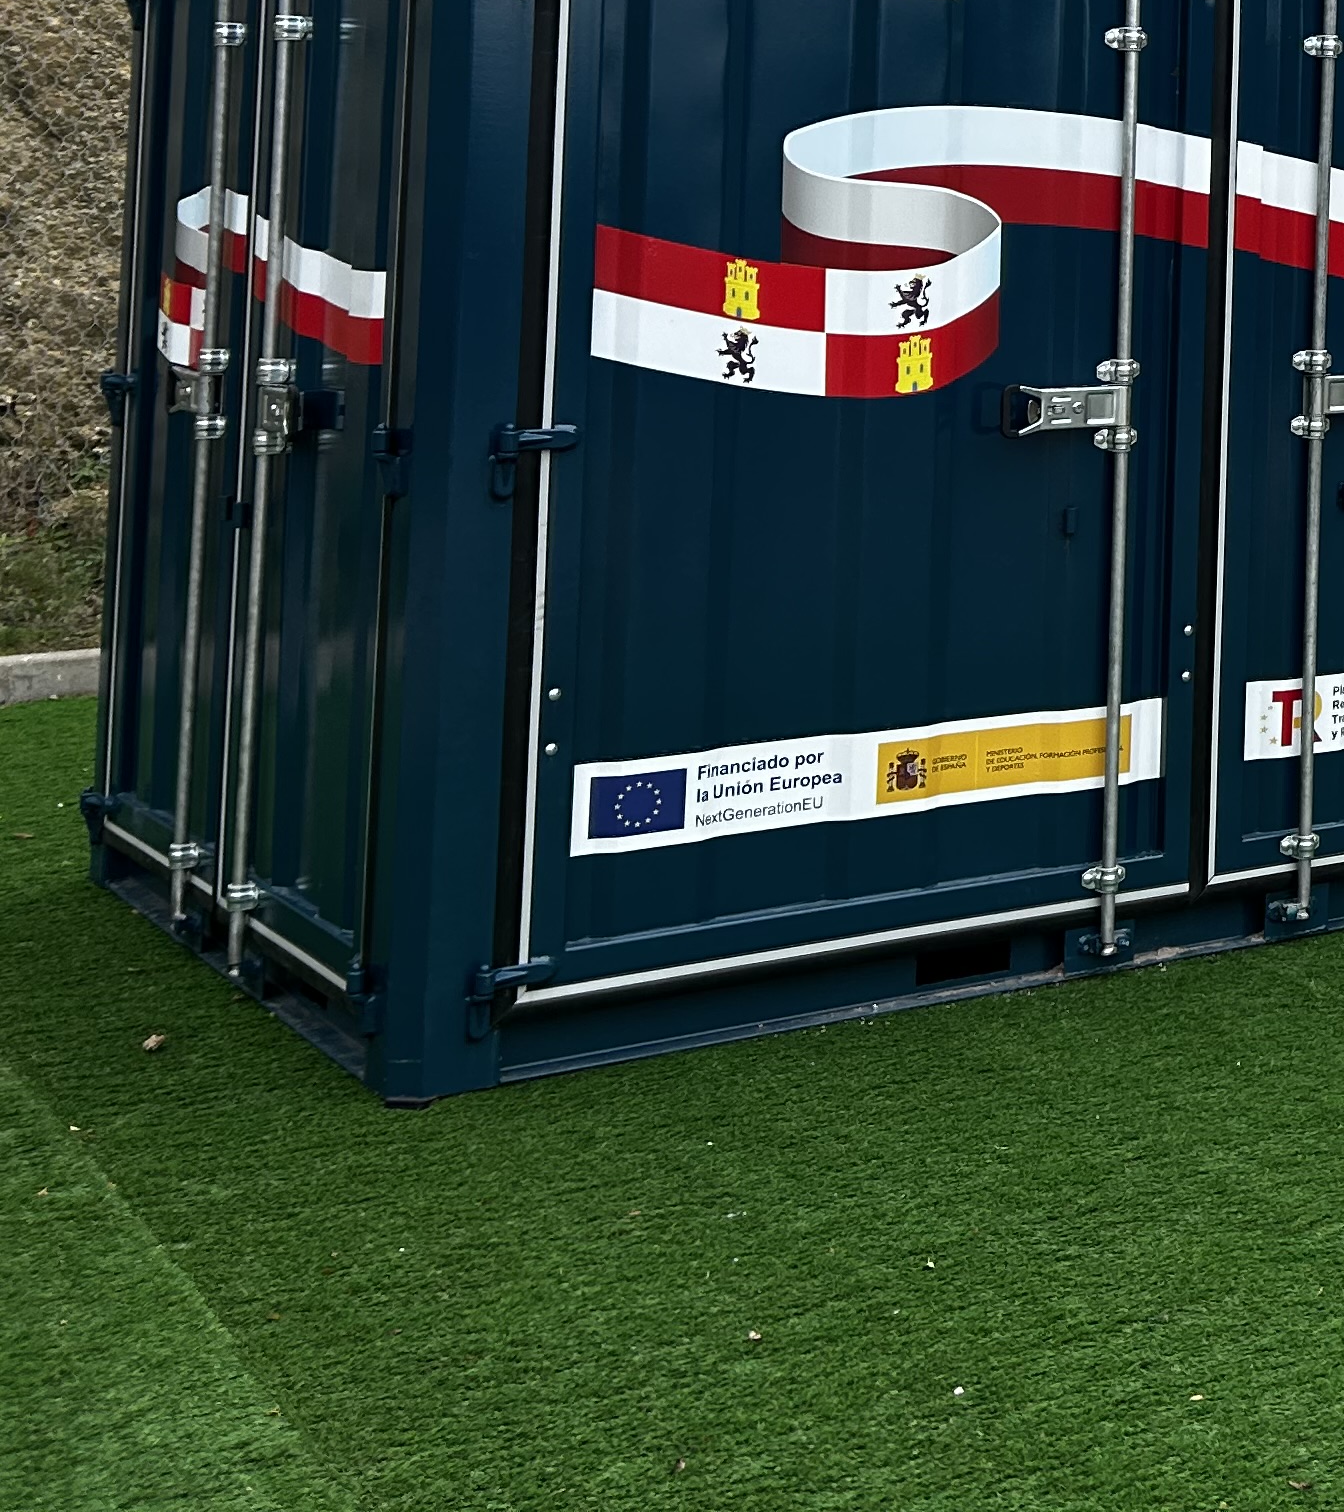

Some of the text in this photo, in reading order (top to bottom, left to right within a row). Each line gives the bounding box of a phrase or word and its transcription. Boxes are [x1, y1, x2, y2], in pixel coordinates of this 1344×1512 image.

[1331, 730, 1338, 740] y
[698, 752, 824, 780] Financiado por
[696, 772, 843, 803] la Unión Europea
[695, 796, 824, 827] NextGenerationEU
